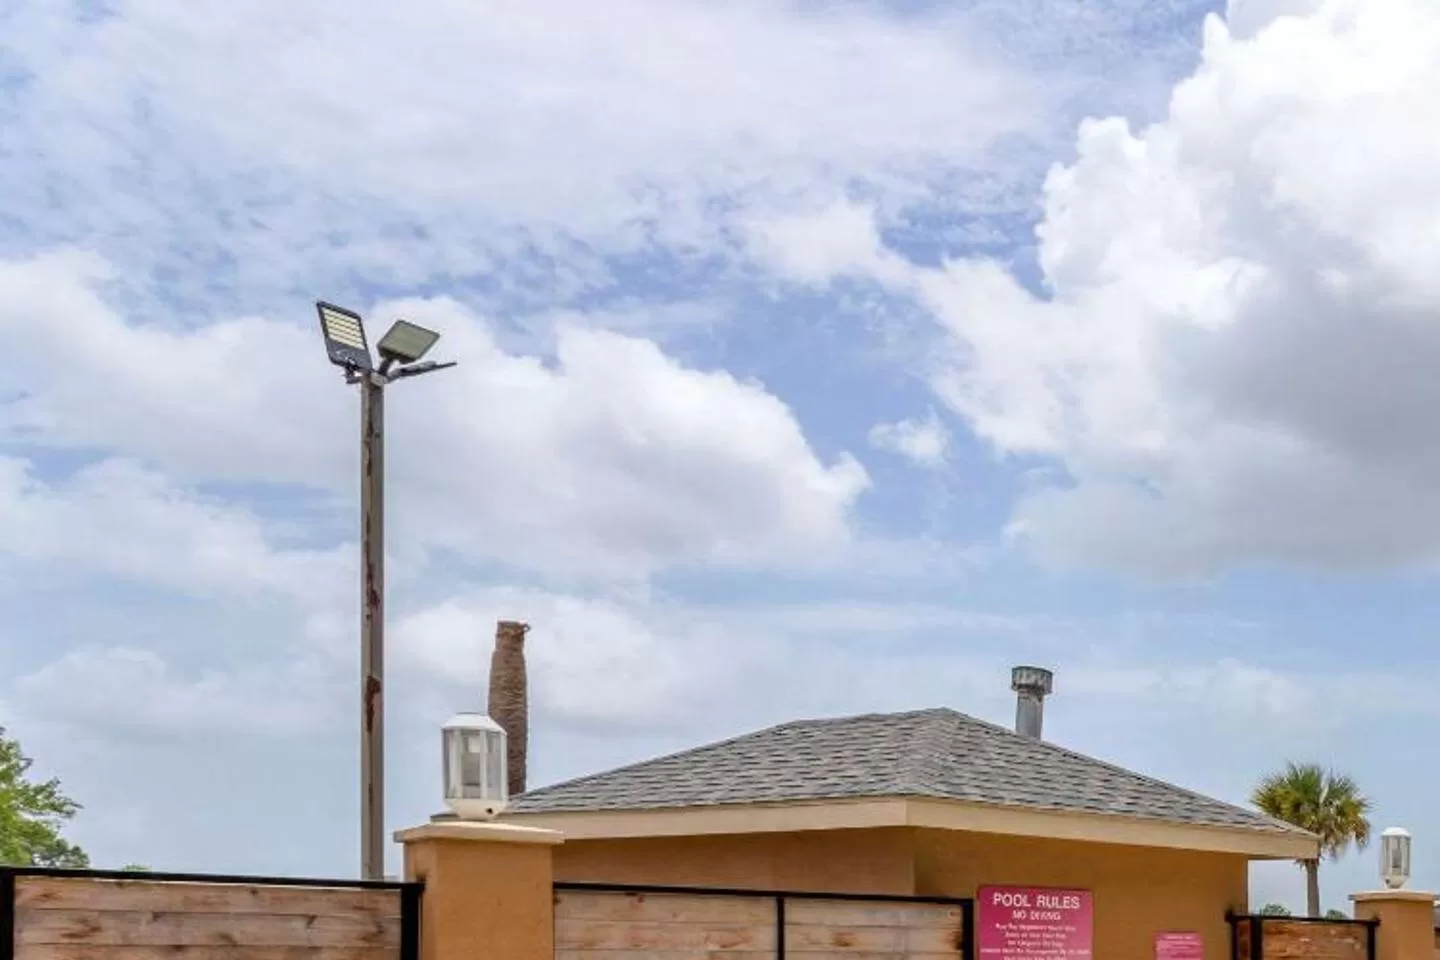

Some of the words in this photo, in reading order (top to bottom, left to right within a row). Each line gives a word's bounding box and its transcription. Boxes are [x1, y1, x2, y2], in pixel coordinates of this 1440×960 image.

[992, 892, 1032, 908] POOL
[1036, 895, 1081, 910] RULES
[1011, 910, 1027, 920] NO
